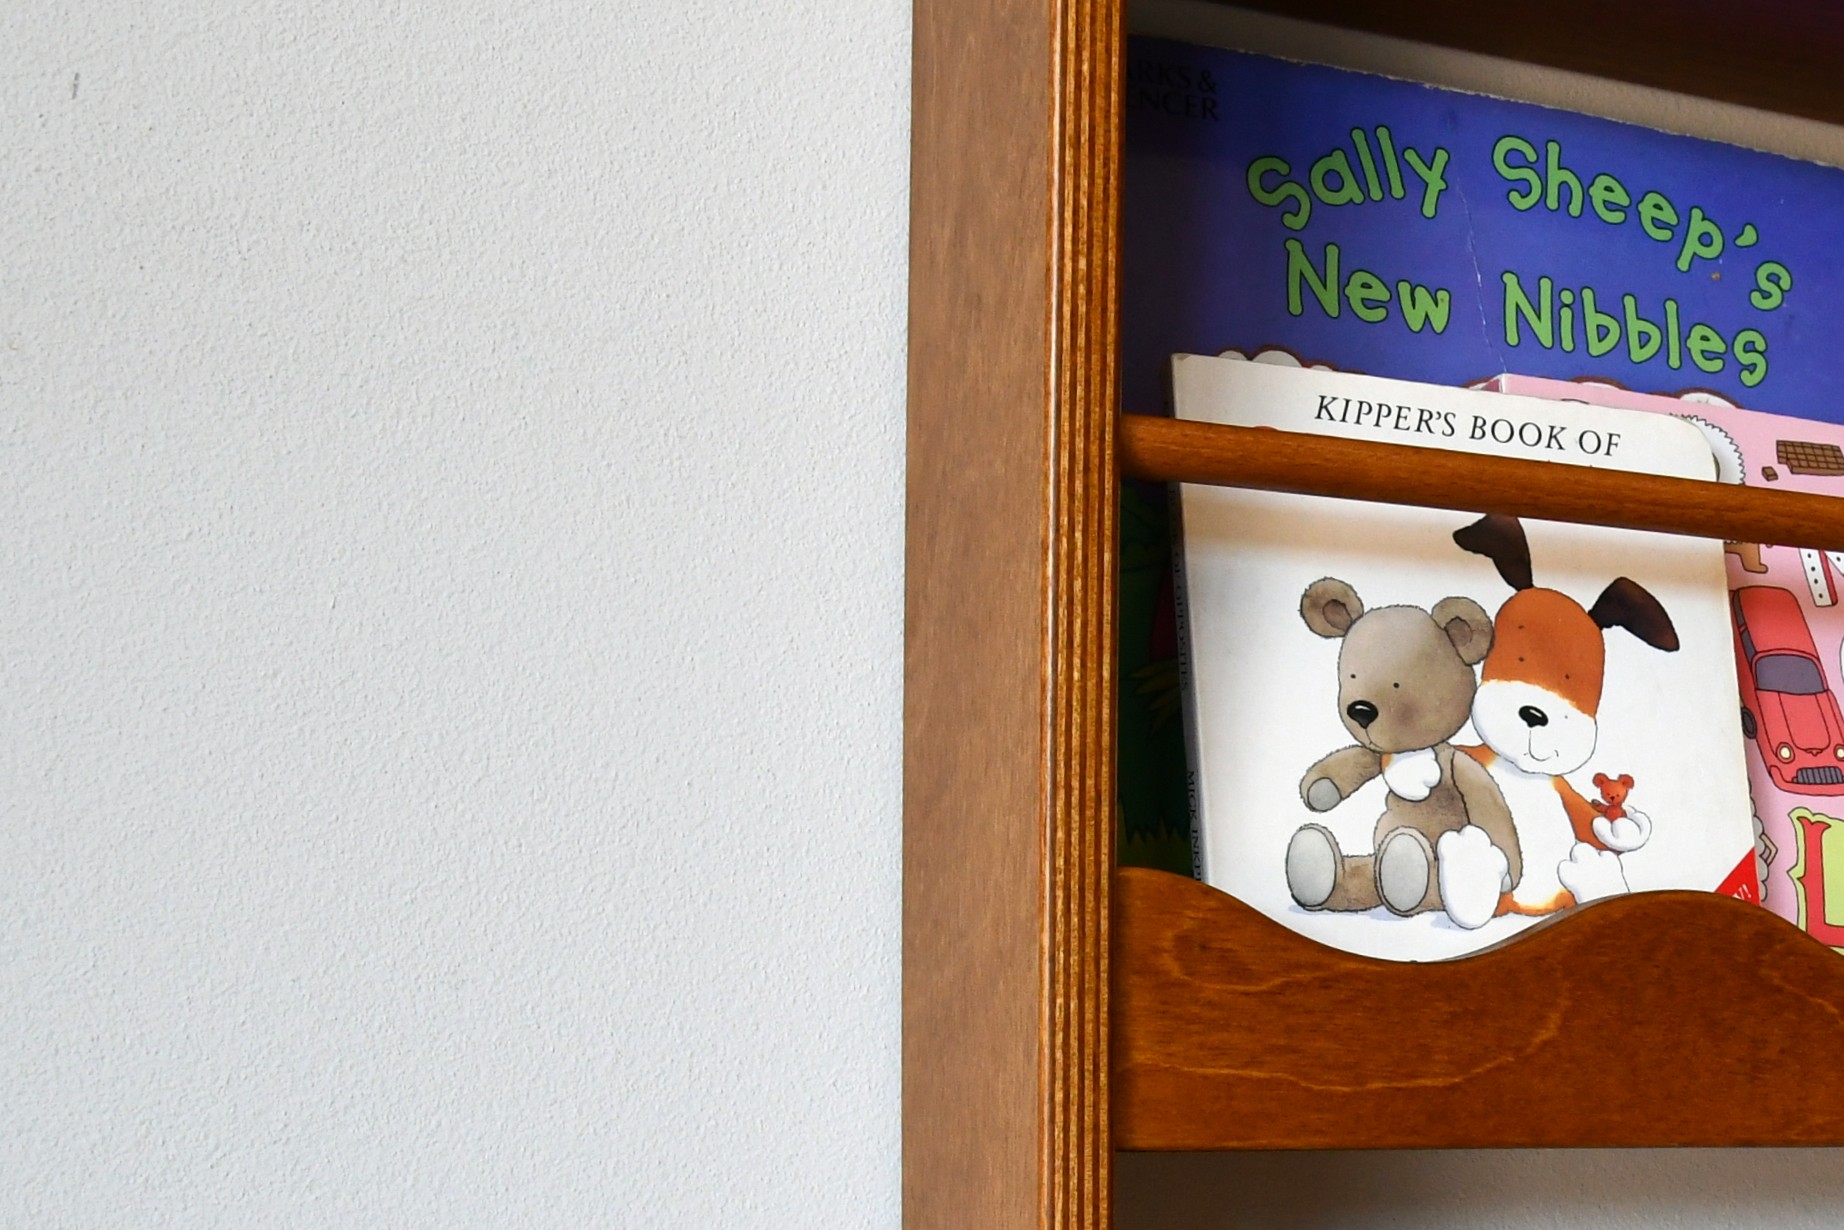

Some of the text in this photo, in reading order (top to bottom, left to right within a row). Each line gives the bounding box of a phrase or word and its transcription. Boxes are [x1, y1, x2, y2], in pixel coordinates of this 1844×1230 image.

[1128, 58, 1192, 90] RKS
[1128, 86, 1219, 122] NCER
[1246, 125, 1793, 310] Sally Sheep's
[1284, 238, 1768, 387] New Nibbles
[1314, 394, 1622, 459] KIPPER'S BOOK OF
[1187, 770, 1197, 821] MICK
